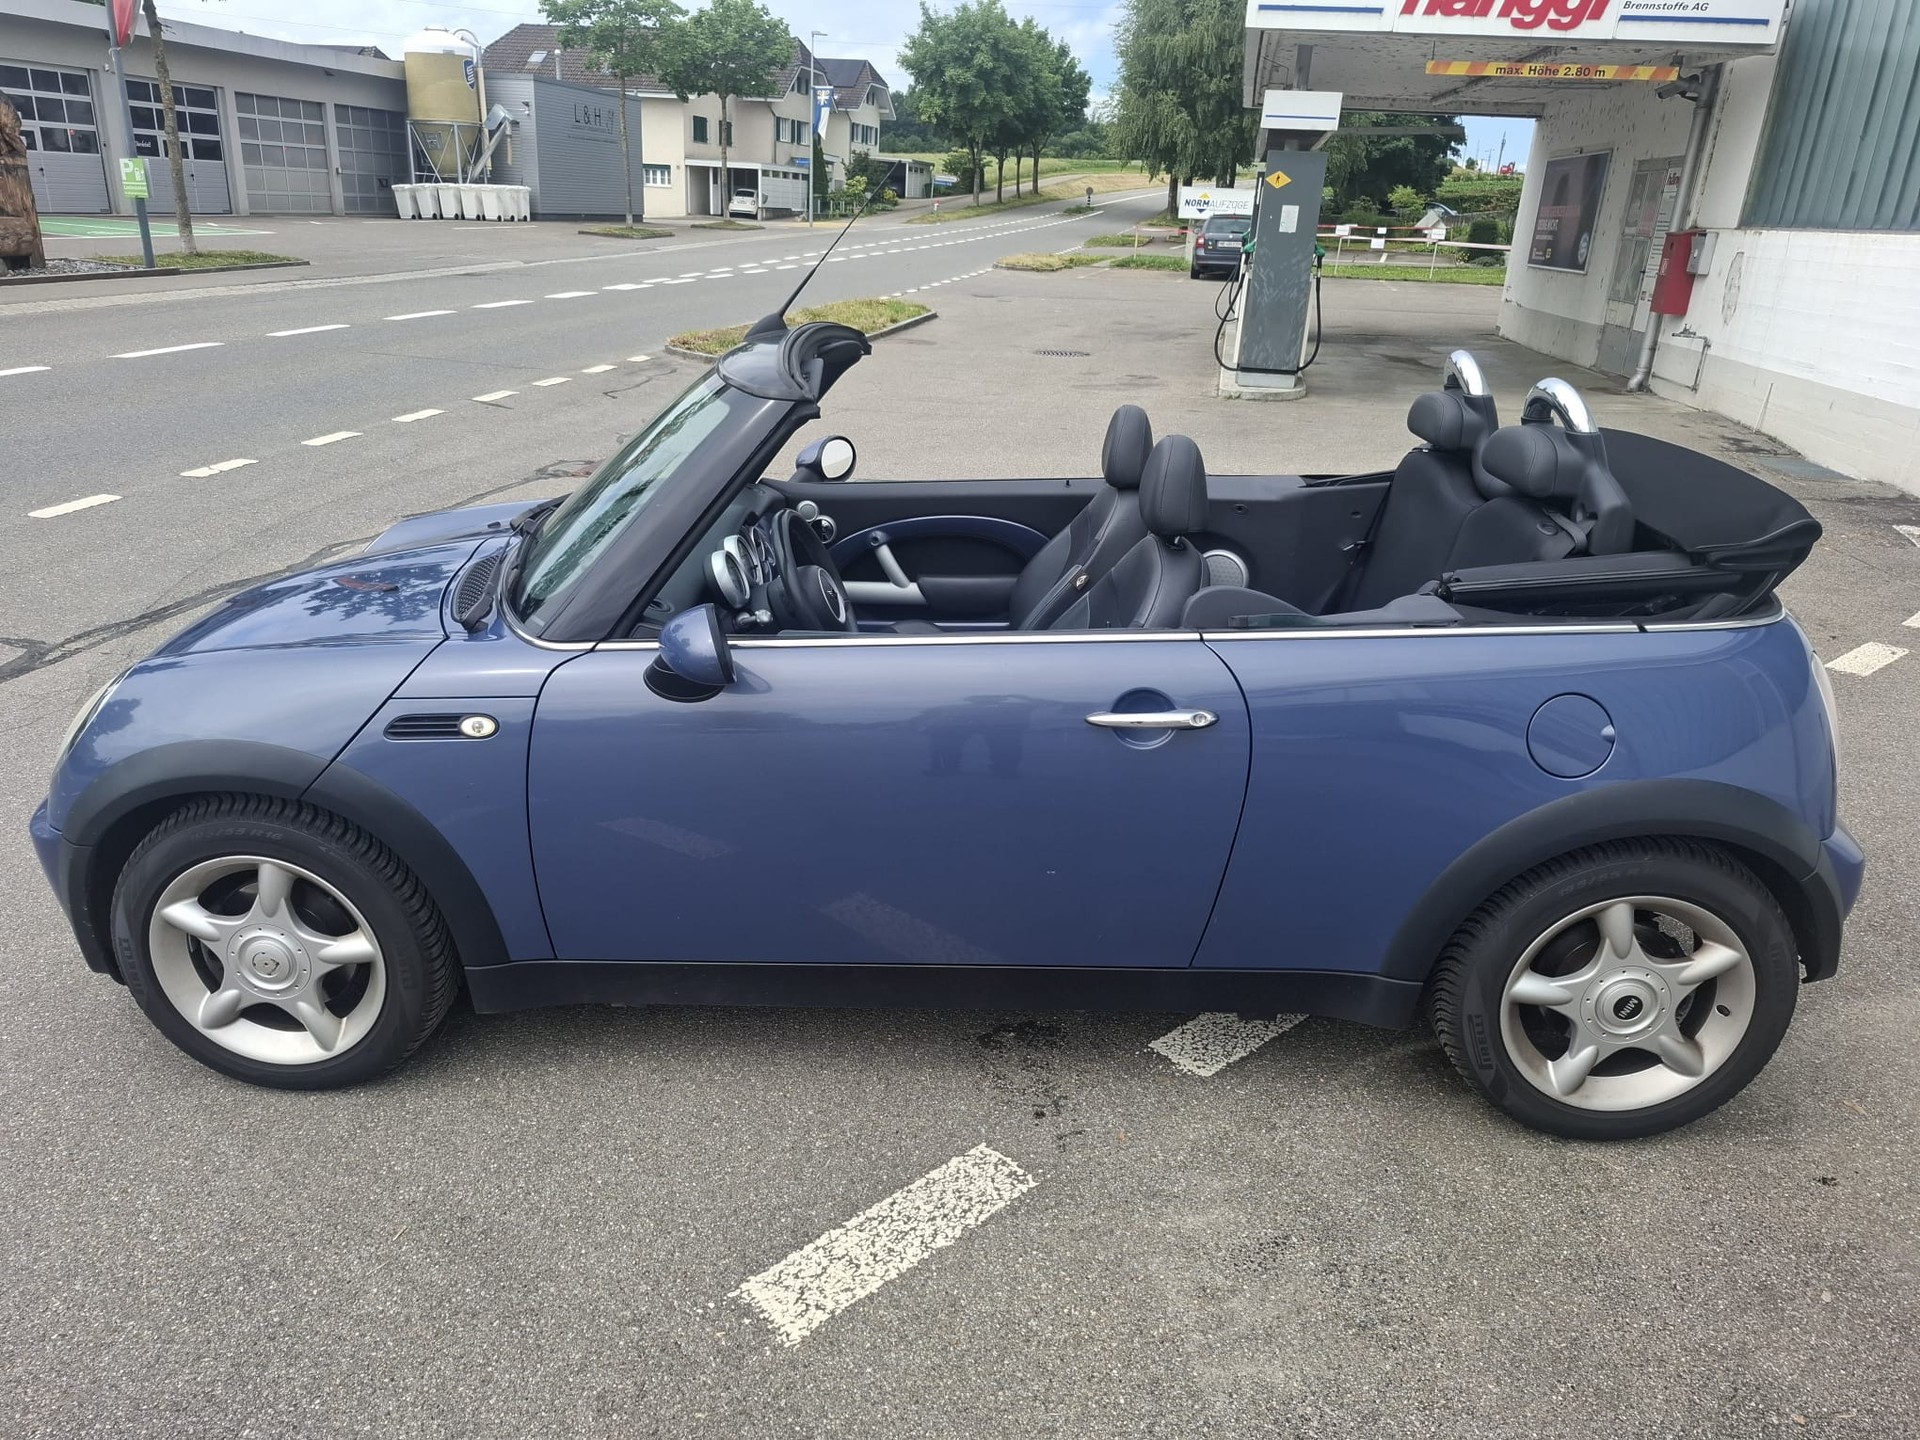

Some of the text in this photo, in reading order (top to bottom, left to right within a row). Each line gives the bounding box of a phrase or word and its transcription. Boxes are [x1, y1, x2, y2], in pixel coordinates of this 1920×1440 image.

[1622, 1, 1709, 12] Brennstoffe AG
[1495, 65, 1606, 77] max. Höhe 2.80 m
[120, 160, 134, 181] P
[1618, 998, 1639, 1019] MINI
